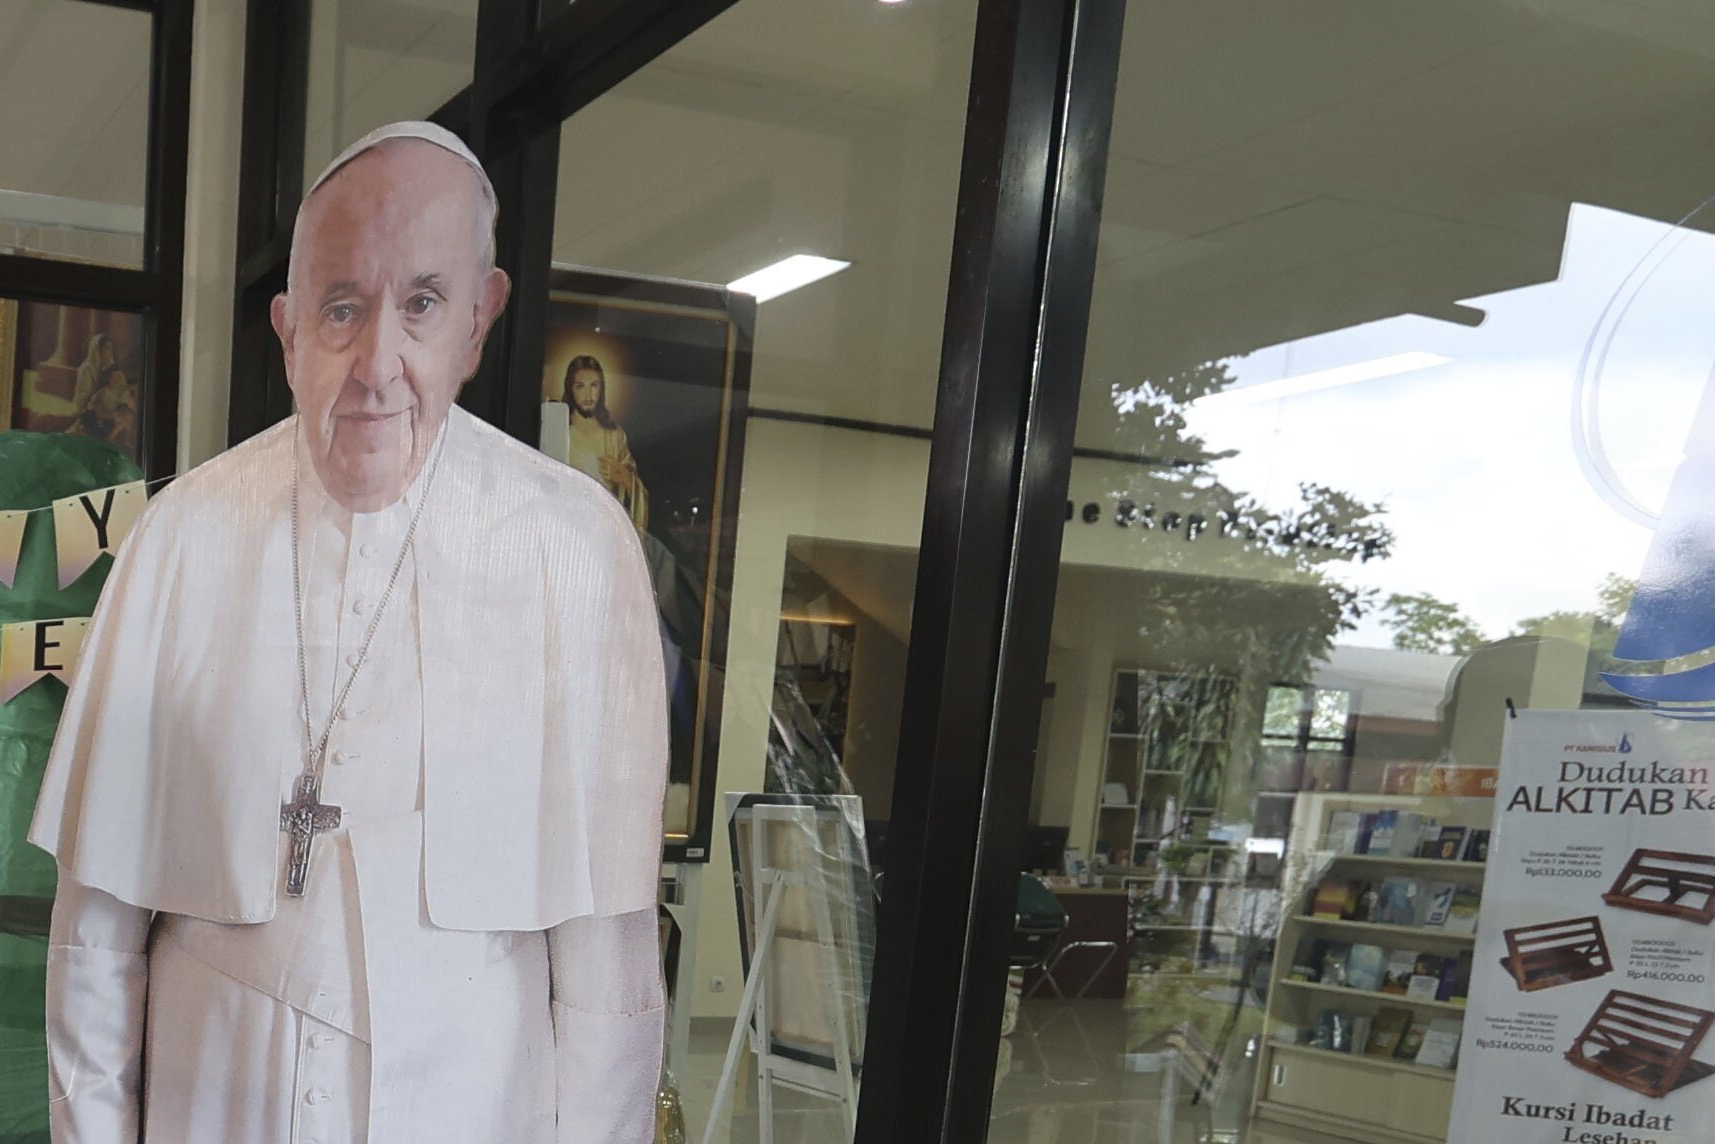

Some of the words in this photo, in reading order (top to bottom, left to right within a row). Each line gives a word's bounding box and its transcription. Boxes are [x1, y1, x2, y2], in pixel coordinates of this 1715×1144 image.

[1557, 760, 1709, 785] Dudukan
[1506, 785, 1675, 816] ALKITAB
[1500, 1095, 1577, 1122] Kursi
[1582, 1103, 1675, 1132] Ibadat
